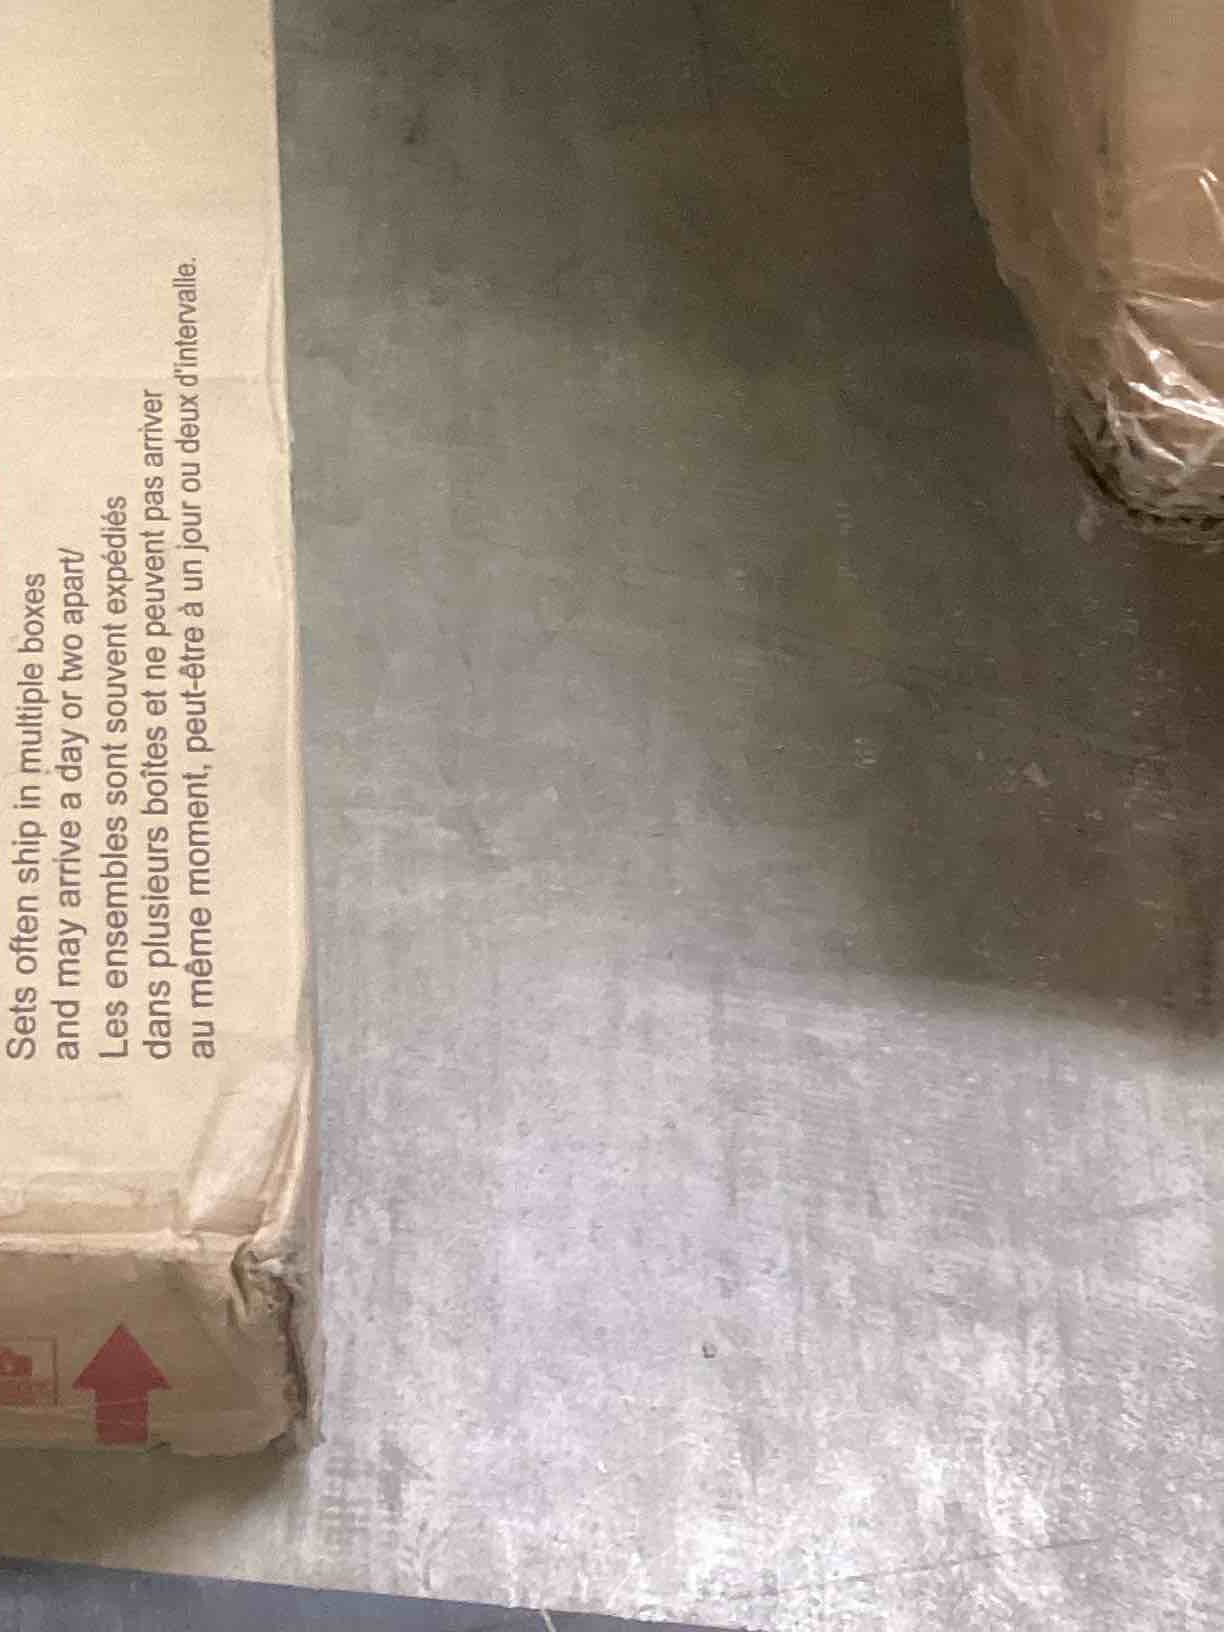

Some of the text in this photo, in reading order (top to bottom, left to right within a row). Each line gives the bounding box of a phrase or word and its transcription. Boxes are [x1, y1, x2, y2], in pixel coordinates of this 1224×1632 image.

[6, 573, 50, 1060] Sets often ship in multiple boxes
[50, 548, 89, 1060] and may arrive a day or two apart/
[98, 496, 134, 1058] Les ensembles sont souvent expédiés
[138, 389, 178, 1059] dans plusieurs boîtes et ne peuvent pas arriver
[173, 258, 215, 1059] au même moment, peut-être à un jour ou deux d'intervalle.
